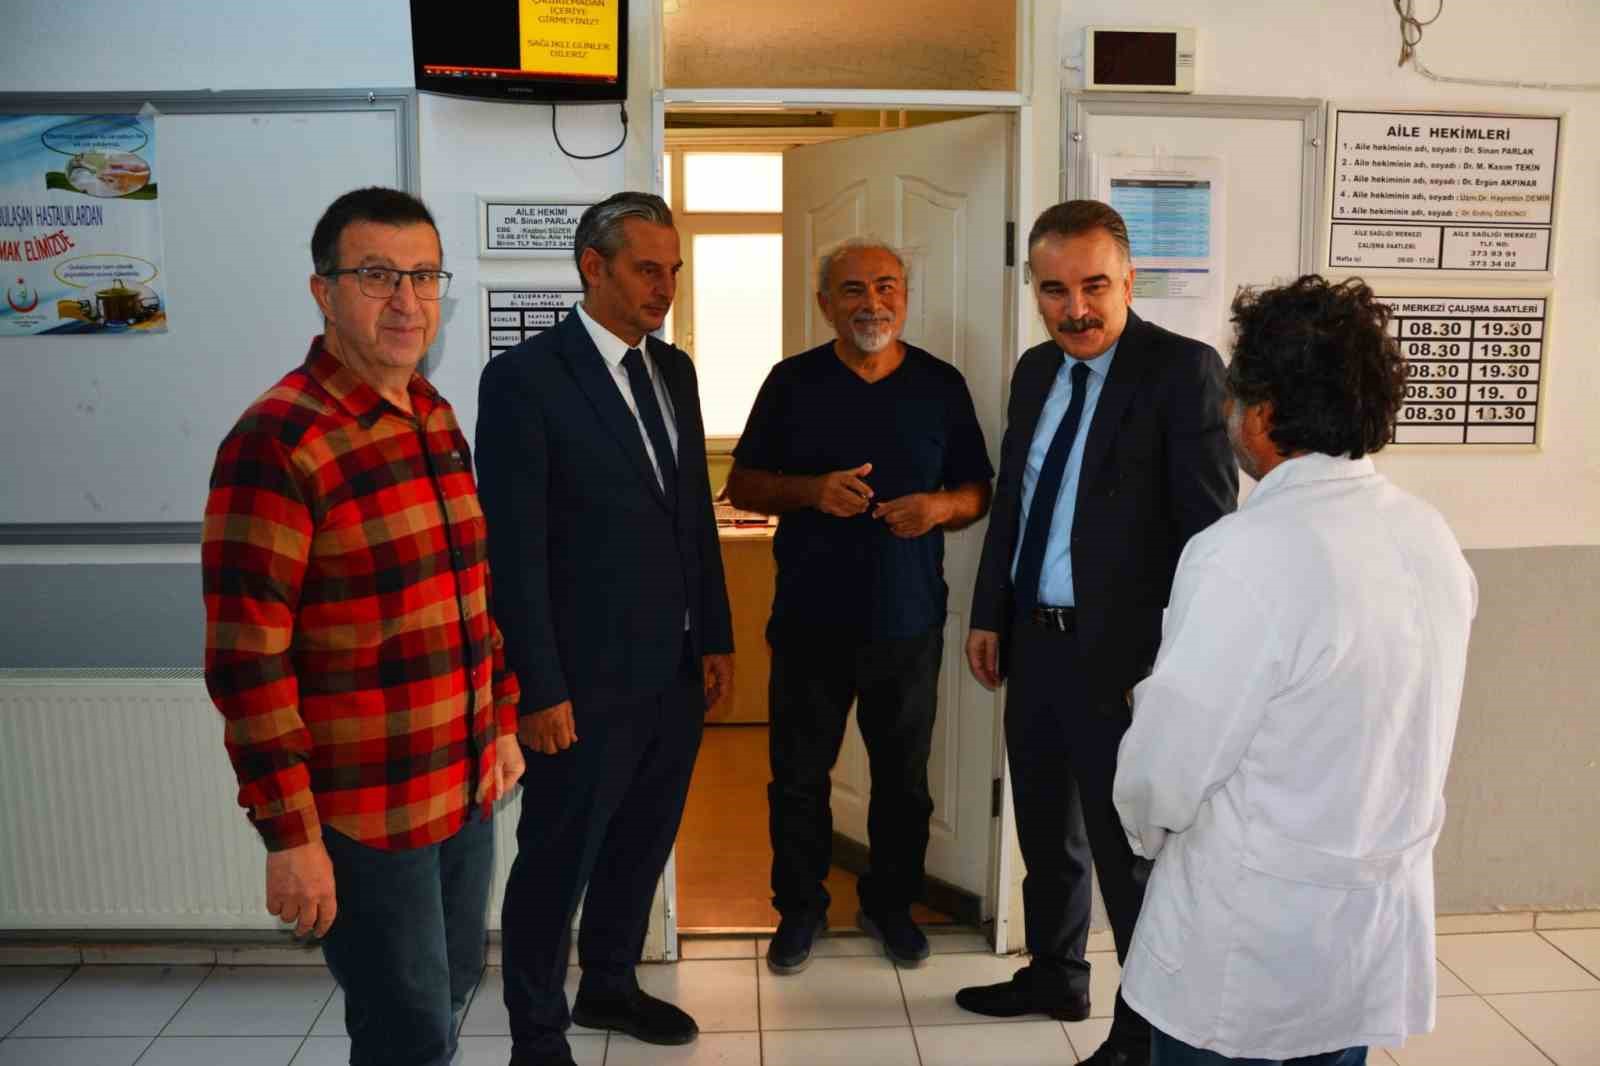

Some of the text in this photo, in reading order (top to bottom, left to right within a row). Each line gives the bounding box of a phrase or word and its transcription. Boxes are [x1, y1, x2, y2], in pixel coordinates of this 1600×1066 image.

[1386, 124, 1510, 140] AİLE HEKİMLERİ
[1372, 144, 1412, 152] hekiminin
[1464, 146, 1474, 154] Dr.
[1478, 146, 1500, 154] Sinan
[1372, 160, 1412, 168] hekiminin
[1464, 162, 1473, 170] Dr.
[1371, 176, 1410, 184] hekiminin
[1370, 192, 1410, 200] hekiminin
[515, 208, 568, 216] AİLE HEKİMİ
[1370, 208, 1408, 216] hekiminin
[24, 229, 76, 262] ELİMİZDE
[1402, 303, 1445, 312] MERKEZİ
[1448, 304, 1490, 315] ÇALIŞMA
[1492, 304, 1538, 313] SAATLERİ
[1410, 322, 1532, 336] 08.30 19.30
[1408, 343, 1530, 357] 08.30 19.30
[1408, 364, 1529, 378] 08.30 19.30
[1406, 386, 1457, 399] 08.30
[1405, 407, 1456, 420] 08.30
